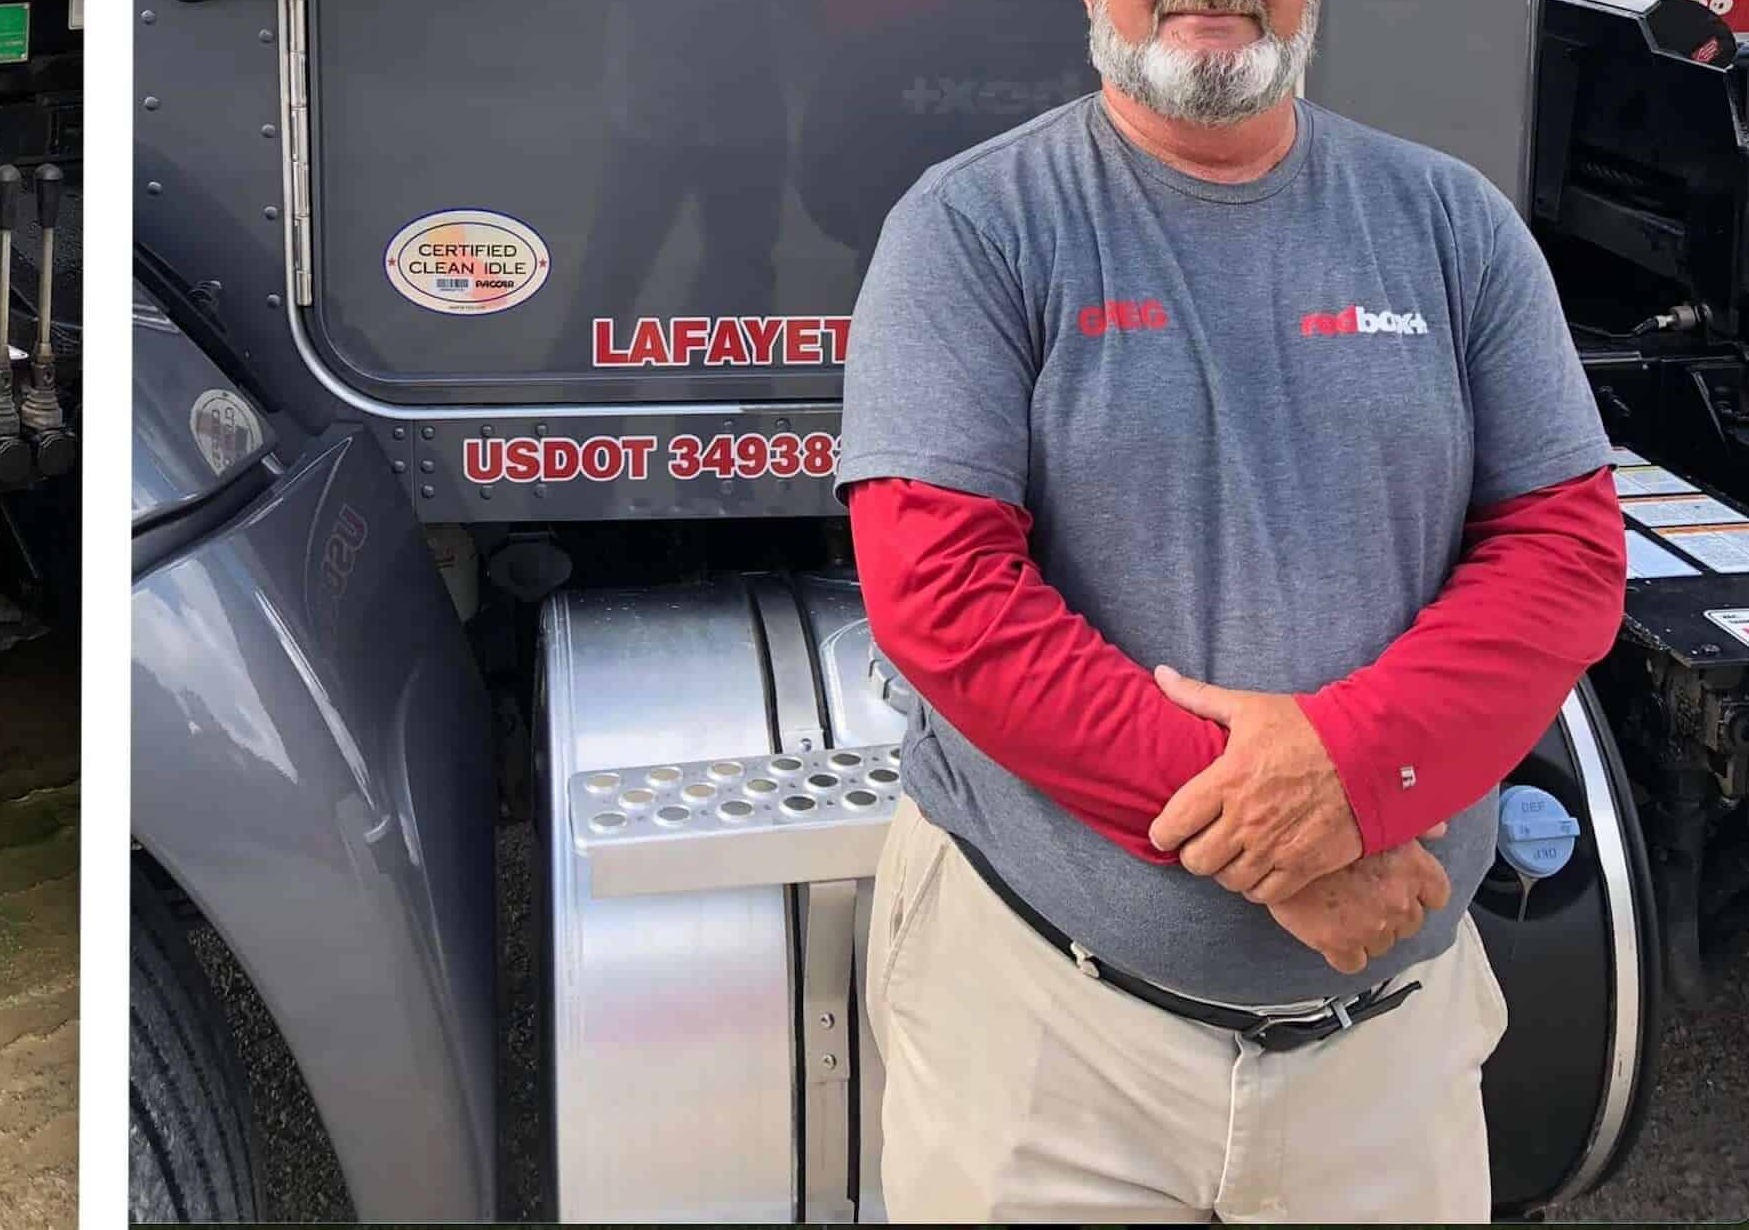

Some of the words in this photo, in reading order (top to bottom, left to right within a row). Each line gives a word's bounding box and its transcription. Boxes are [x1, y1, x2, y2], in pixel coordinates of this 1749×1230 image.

[418, 243, 517, 258] CERTIFIED
[408, 261, 474, 275] CLEAN
[484, 262, 527, 275] IDLE
[475, 280, 515, 289] PACCAR
[463, 436, 658, 484] USDOT
[668, 432, 843, 480] 34938
